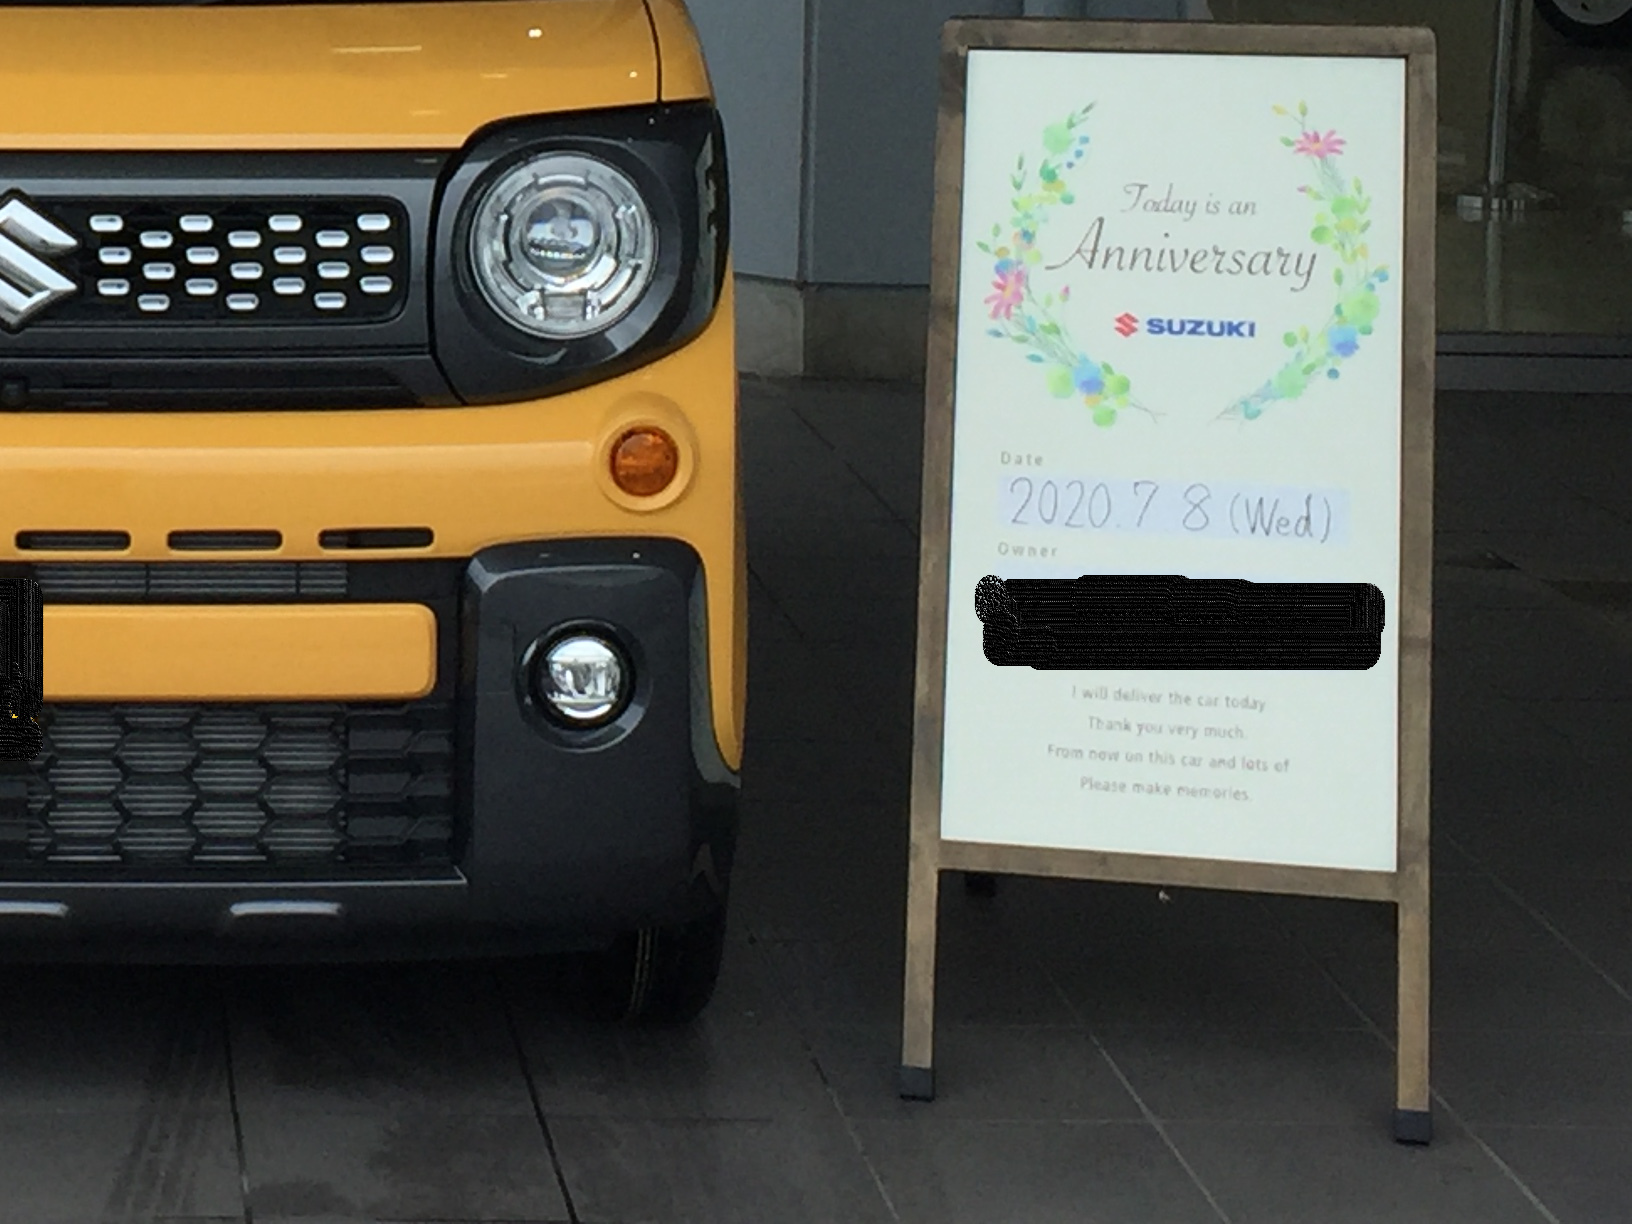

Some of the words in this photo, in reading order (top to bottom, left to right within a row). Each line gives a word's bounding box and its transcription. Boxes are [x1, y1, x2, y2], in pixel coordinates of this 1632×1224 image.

[1120, 183, 1197, 221] Today
[1205, 194, 1221, 216] is
[1228, 200, 1257, 216] an
[1045, 216, 1317, 292] Anniversary
[1146, 318, 1256, 338] SUZUKI
[1000, 451, 1043, 466] Date
[1230, 492, 1332, 544] (Wed)
[997, 542, 1059, 558] Owner
[1082, 686, 1108, 701] will
[1113, 687, 1163, 704] deliver
[1168, 691, 1192, 706] the
[1197, 694, 1219, 708] car
[1088, 715, 1131, 733] Thank
[1137, 722, 1163, 737] you
[1168, 724, 1199, 740] very
[1047, 743, 1084, 760] From
[1088, 748, 1119, 762] now
[1149, 750, 1175, 765] this
[1181, 754, 1203, 768] car
[1209, 755, 1236, 770] and
[1241, 756, 1269, 773] lots
[1274, 759, 1290, 774] of
[1080, 775, 1126, 793] Please
[1132, 780, 1171, 796] make
